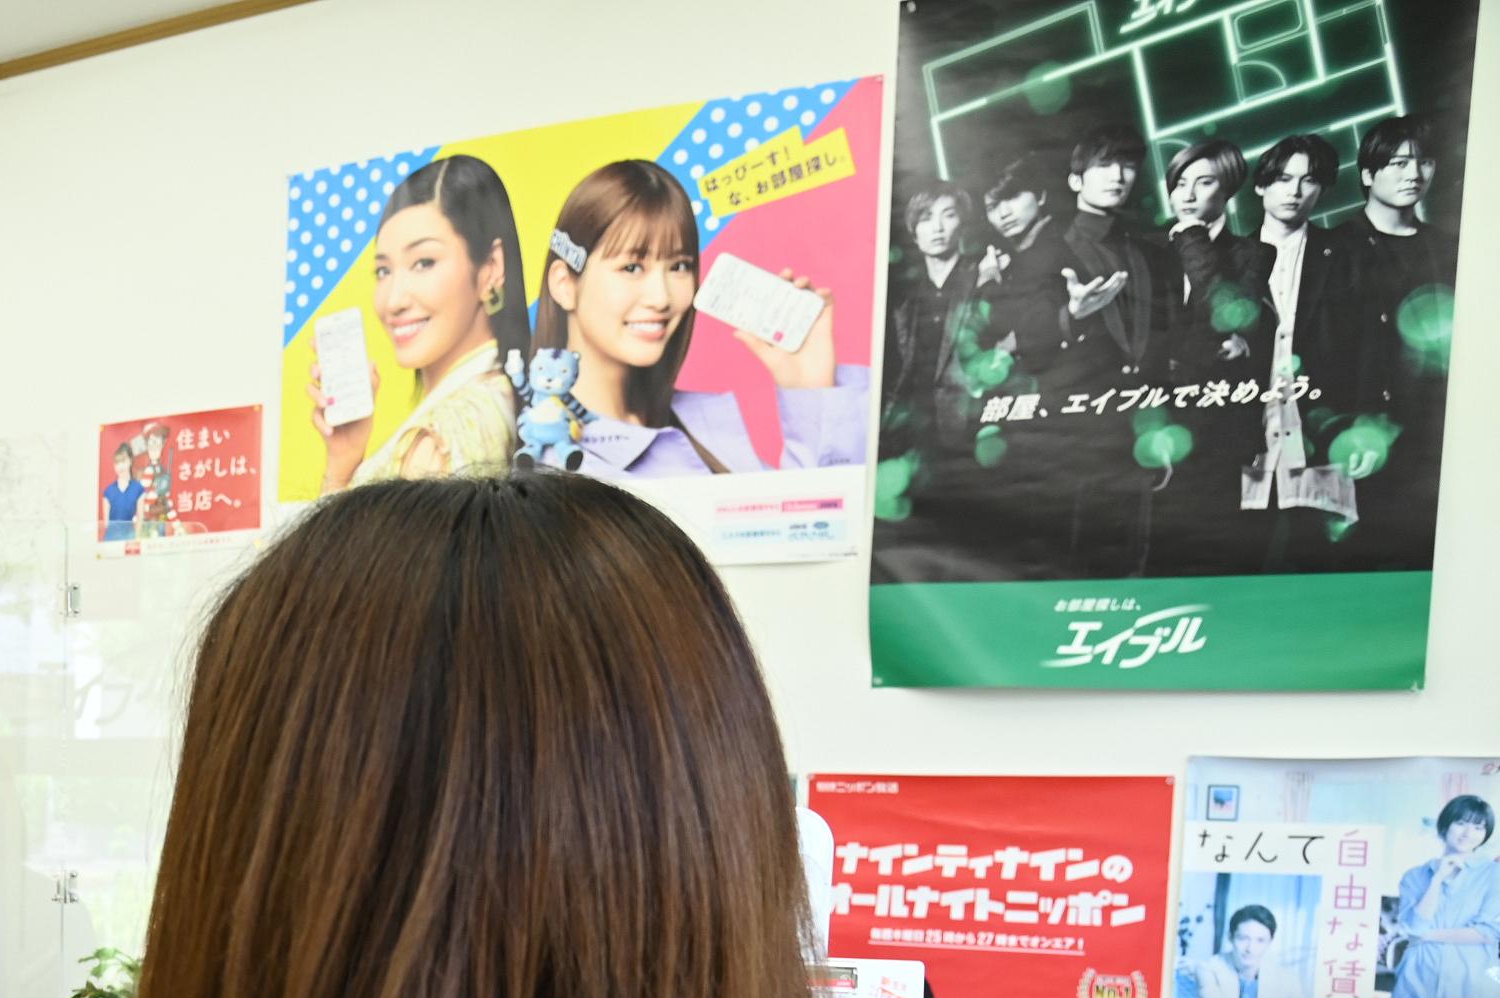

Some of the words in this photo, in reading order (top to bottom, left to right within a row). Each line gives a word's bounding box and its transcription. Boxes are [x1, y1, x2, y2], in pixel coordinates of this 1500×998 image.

[980, 376, 1323, 423] 部屋、エイブルで決めよう。
[176, 427, 231, 450] 住まい
[179, 455, 257, 481] さがしは、
[178, 489, 241, 513] 当店へ。
[1050, 613, 1209, 669] エイブル
[835, 842, 1133, 883] ナインティナインの
[1198, 829, 1326, 865] なんて
